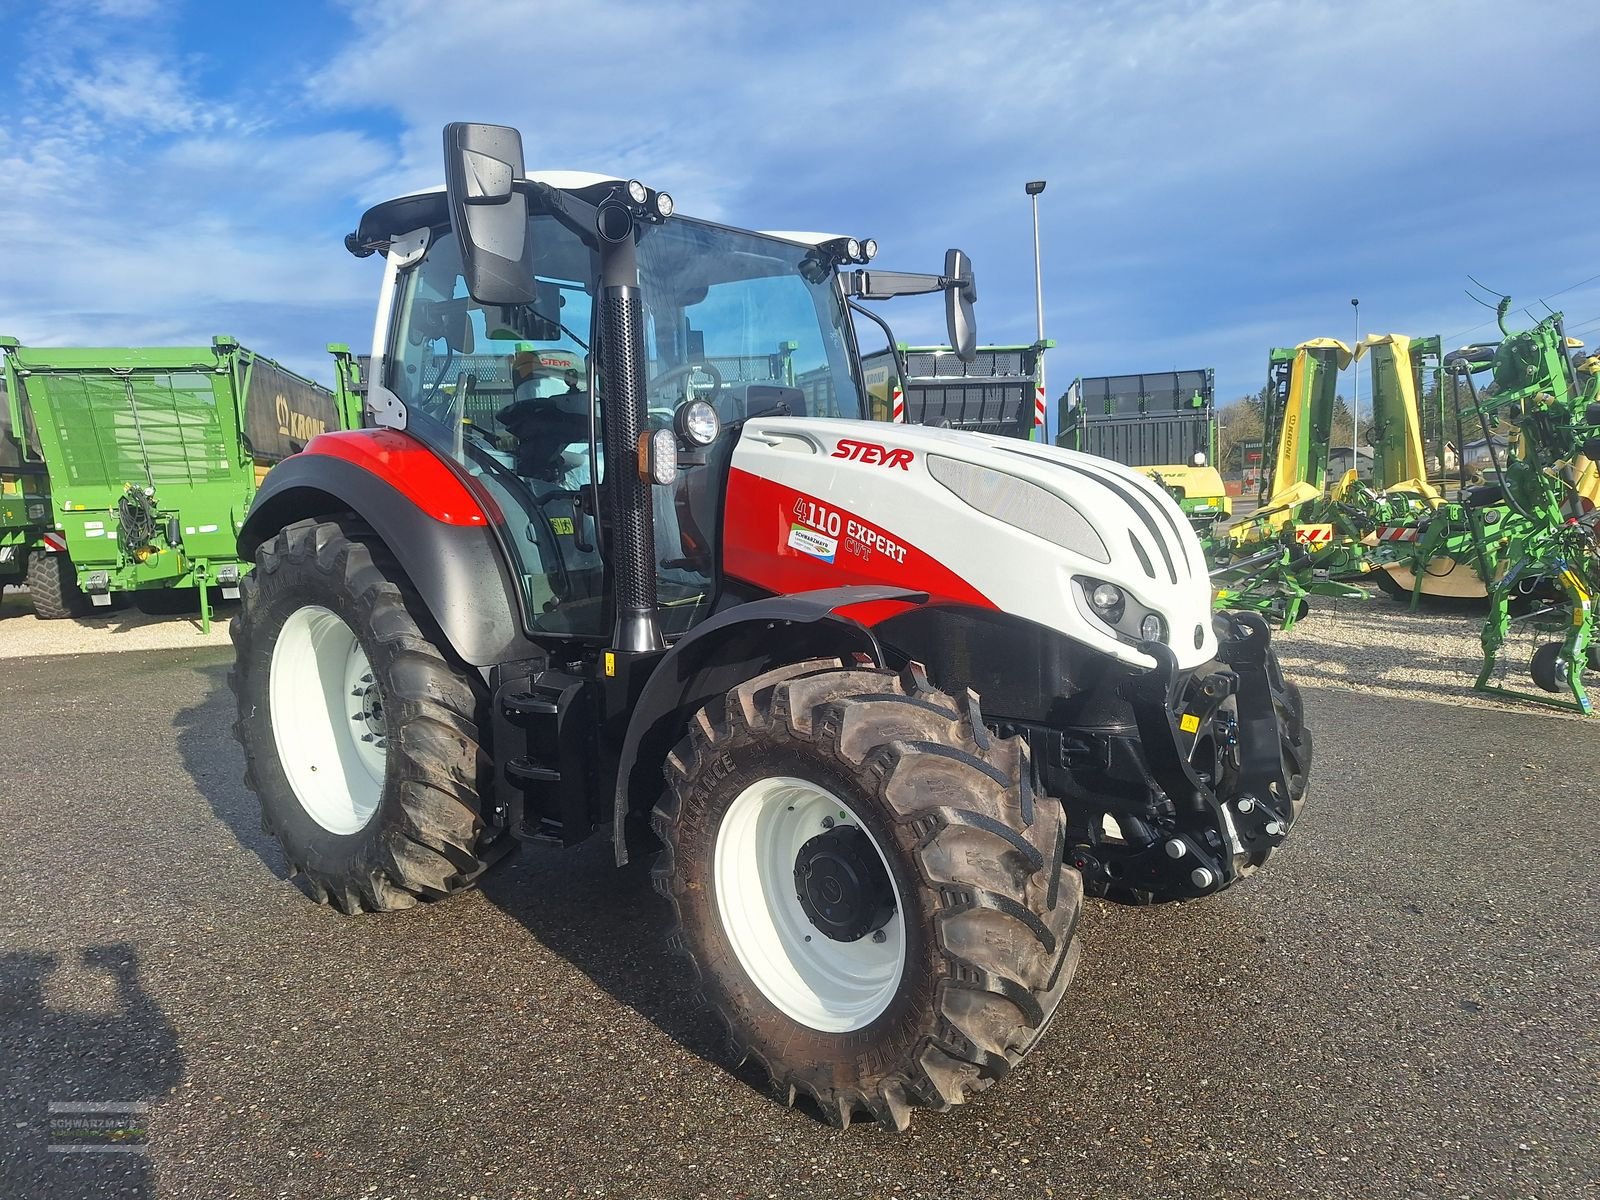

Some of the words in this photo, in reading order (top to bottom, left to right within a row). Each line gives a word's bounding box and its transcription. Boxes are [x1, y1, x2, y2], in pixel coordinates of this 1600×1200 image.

[541, 358, 571, 367] STEYR
[831, 438, 914, 471] STEYR
[1285, 425, 1294, 461] KRONE
[793, 498, 841, 537] 4110
[844, 536, 872, 561] CVT
[847, 519, 907, 564] EXPERT
